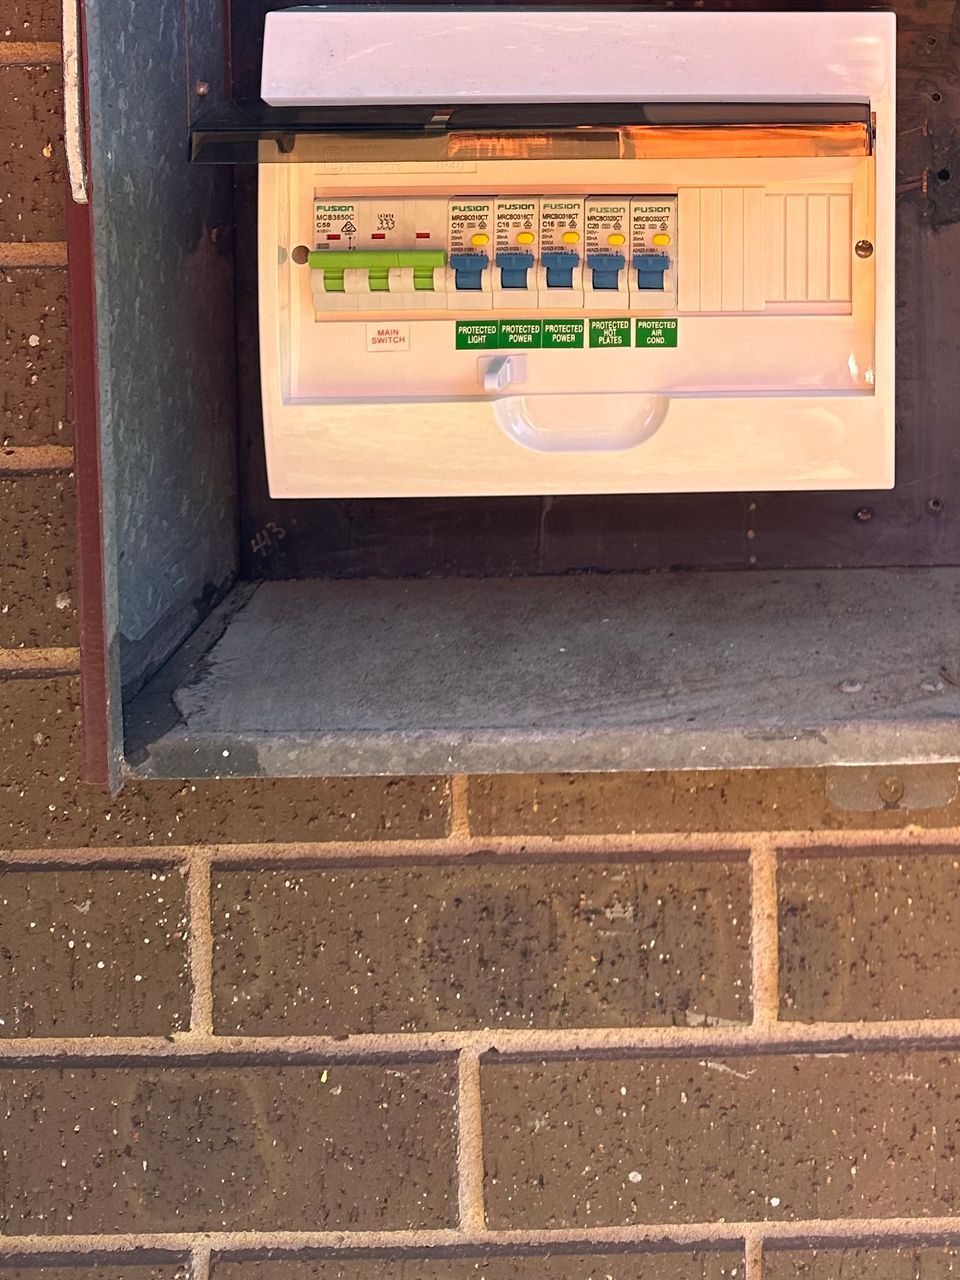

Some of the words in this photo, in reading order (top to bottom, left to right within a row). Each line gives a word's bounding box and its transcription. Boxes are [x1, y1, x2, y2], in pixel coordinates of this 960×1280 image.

[545, 324, 583, 333] PROTECTED
[592, 321, 629, 330] PROTECTED
[638, 321, 676, 329] PROTECTED
[458, 326, 496, 334] PROTECTED
[502, 325, 540, 334] PROTECTED
[603, 328, 617, 336] HOT
[651, 329, 663, 337] AIR
[372, 336, 406, 344] SWITCH
[468, 334, 486, 344] LIGHT
[508, 334, 533, 342] POWER
[552, 334, 576, 342] POWER
[598, 336, 622, 344] PLATES
